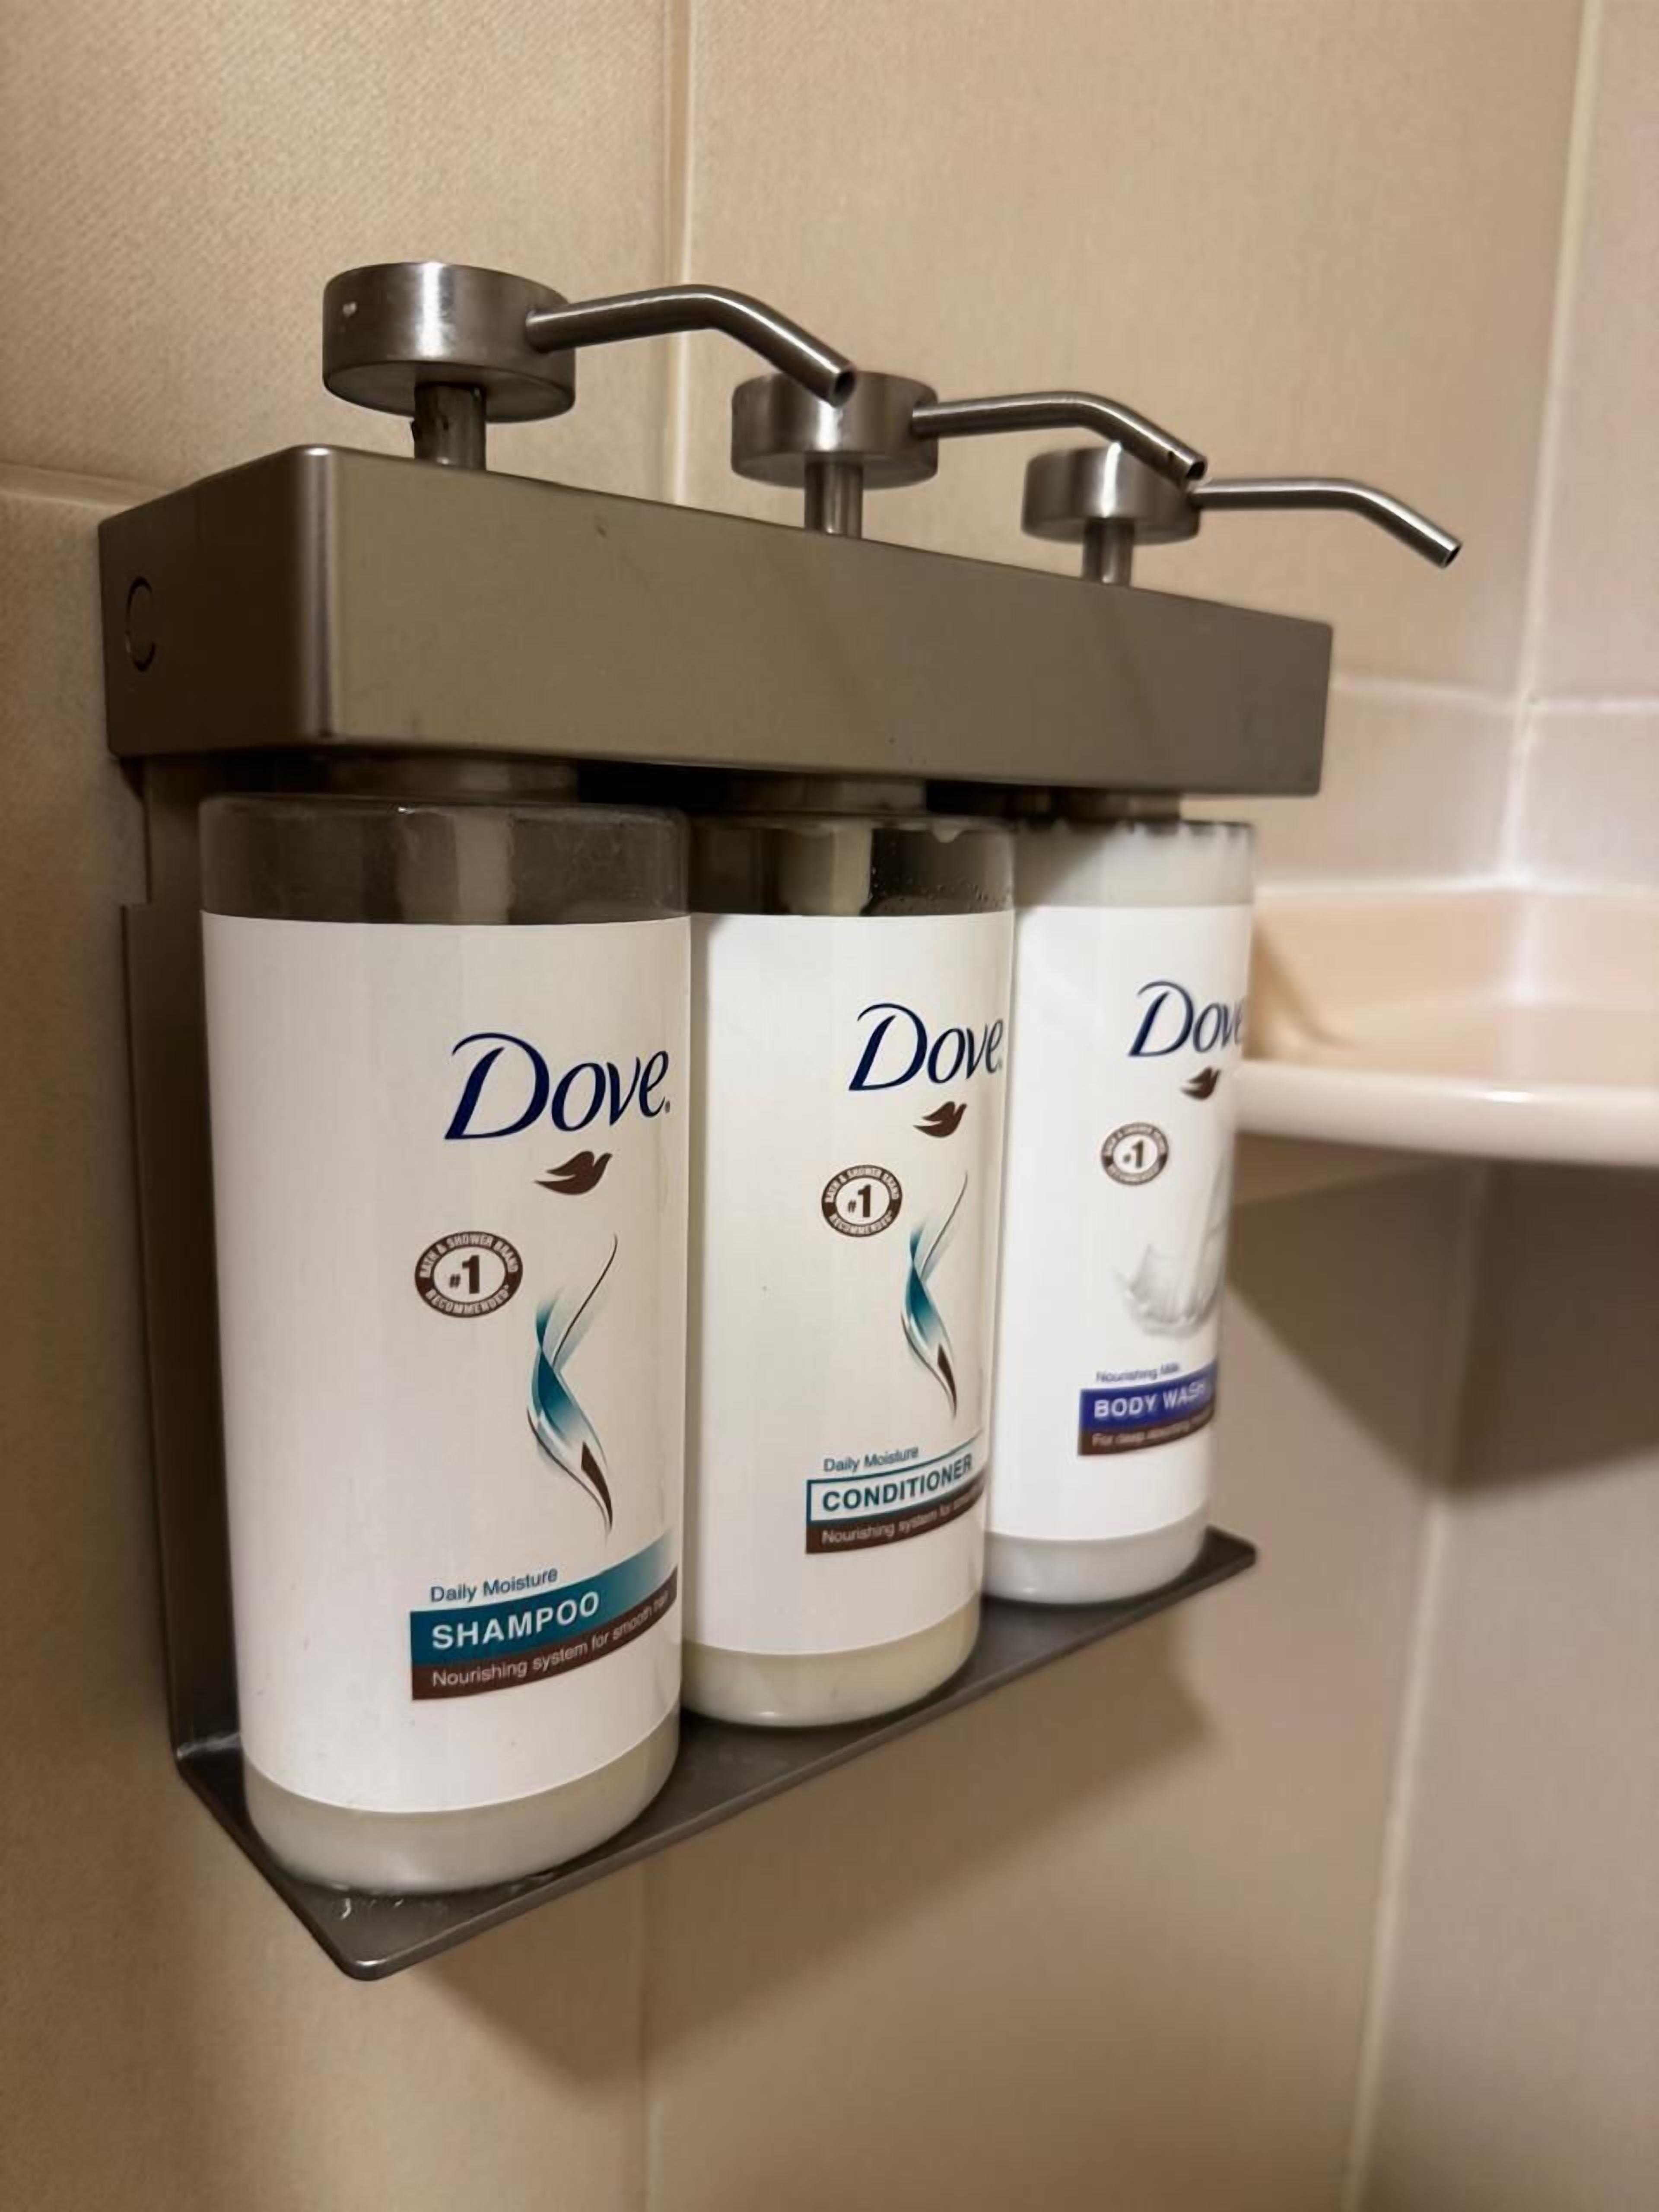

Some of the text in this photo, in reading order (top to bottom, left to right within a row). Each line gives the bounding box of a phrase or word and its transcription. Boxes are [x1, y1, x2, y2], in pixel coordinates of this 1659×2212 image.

[848, 1184, 871, 1218] #1
[449, 1254, 480, 1294] #1
[1094, 1394, 1159, 1418] BODY
[822, 1452, 973, 1512] CONDITIONER
[823, 1456, 861, 1472] Daily
[821, 1522, 895, 1545] Nourishing
[430, 1567, 558, 1603] Daily Moisture
[432, 1591, 600, 1650] SHAMPOO
[432, 1659, 528, 1687] Nourishing
[533, 1641, 588, 1672] system
[591, 1631, 609, 1651] for
